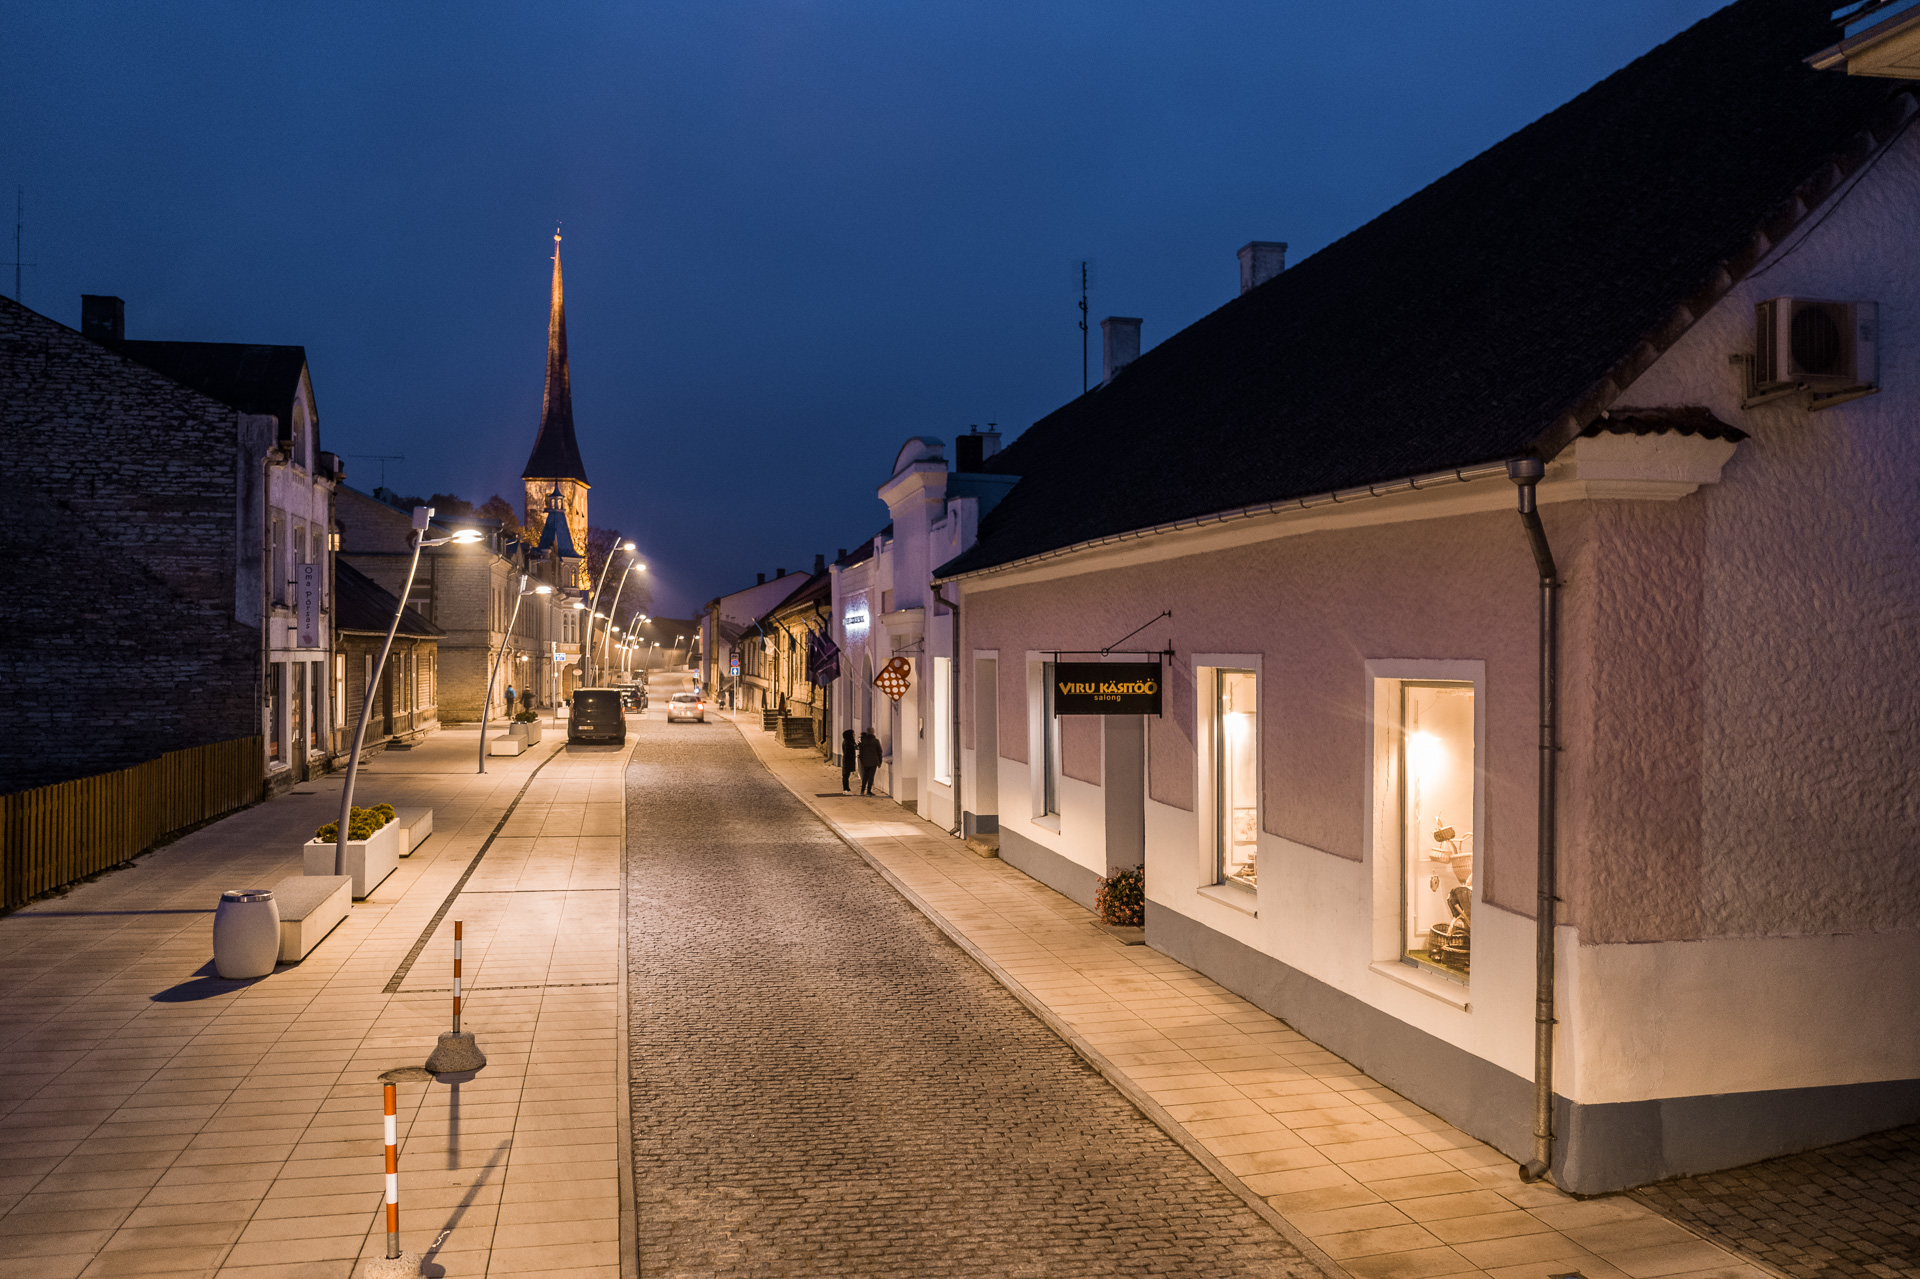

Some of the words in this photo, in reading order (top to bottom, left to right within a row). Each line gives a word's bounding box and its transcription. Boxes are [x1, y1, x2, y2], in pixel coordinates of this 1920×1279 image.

[304, 566, 313, 587] Oma
[1059, 682, 1095, 695] VIRU
[1100, 678, 1158, 695] KÄSITÖÖ
